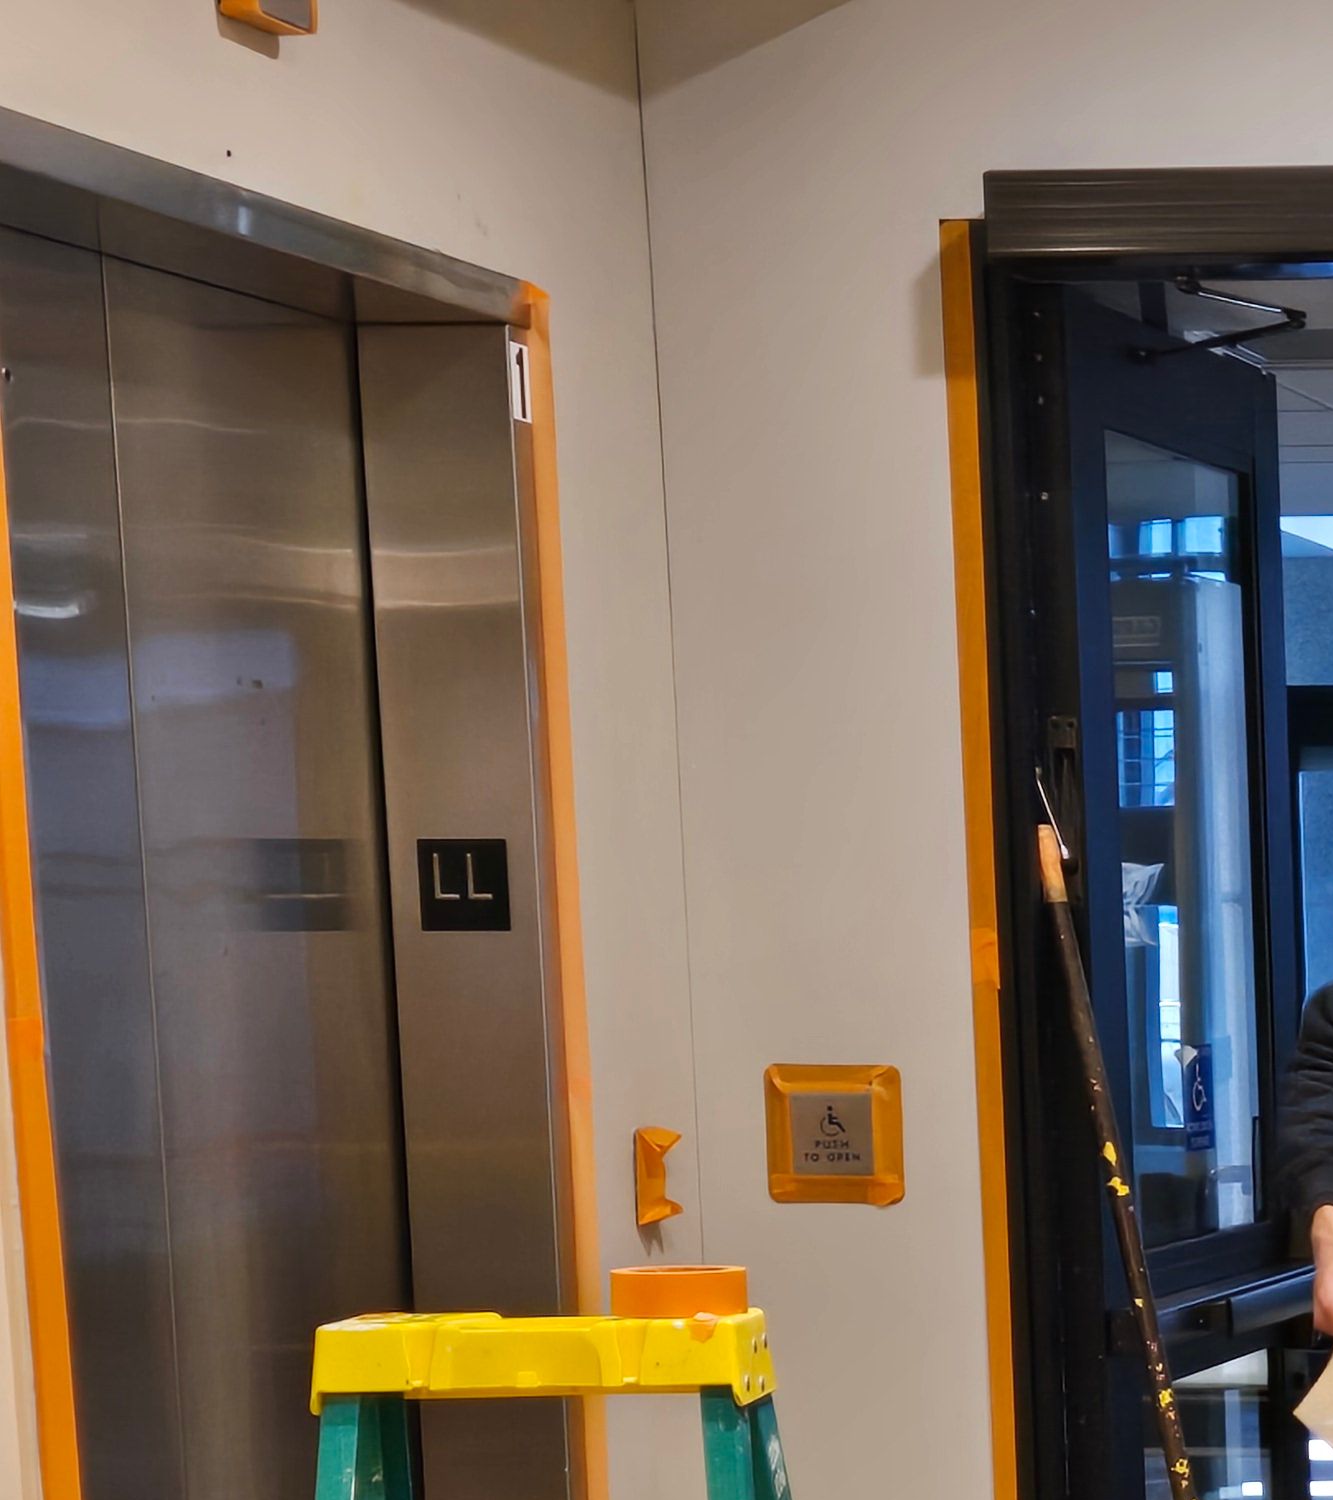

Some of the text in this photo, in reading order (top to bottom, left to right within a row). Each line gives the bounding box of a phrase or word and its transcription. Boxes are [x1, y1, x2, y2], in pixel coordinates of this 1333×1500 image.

[432, 852, 493, 899] LL
[815, 1140, 850, 1150] PUSH
[804, 1153, 861, 1162] TO OPEN
